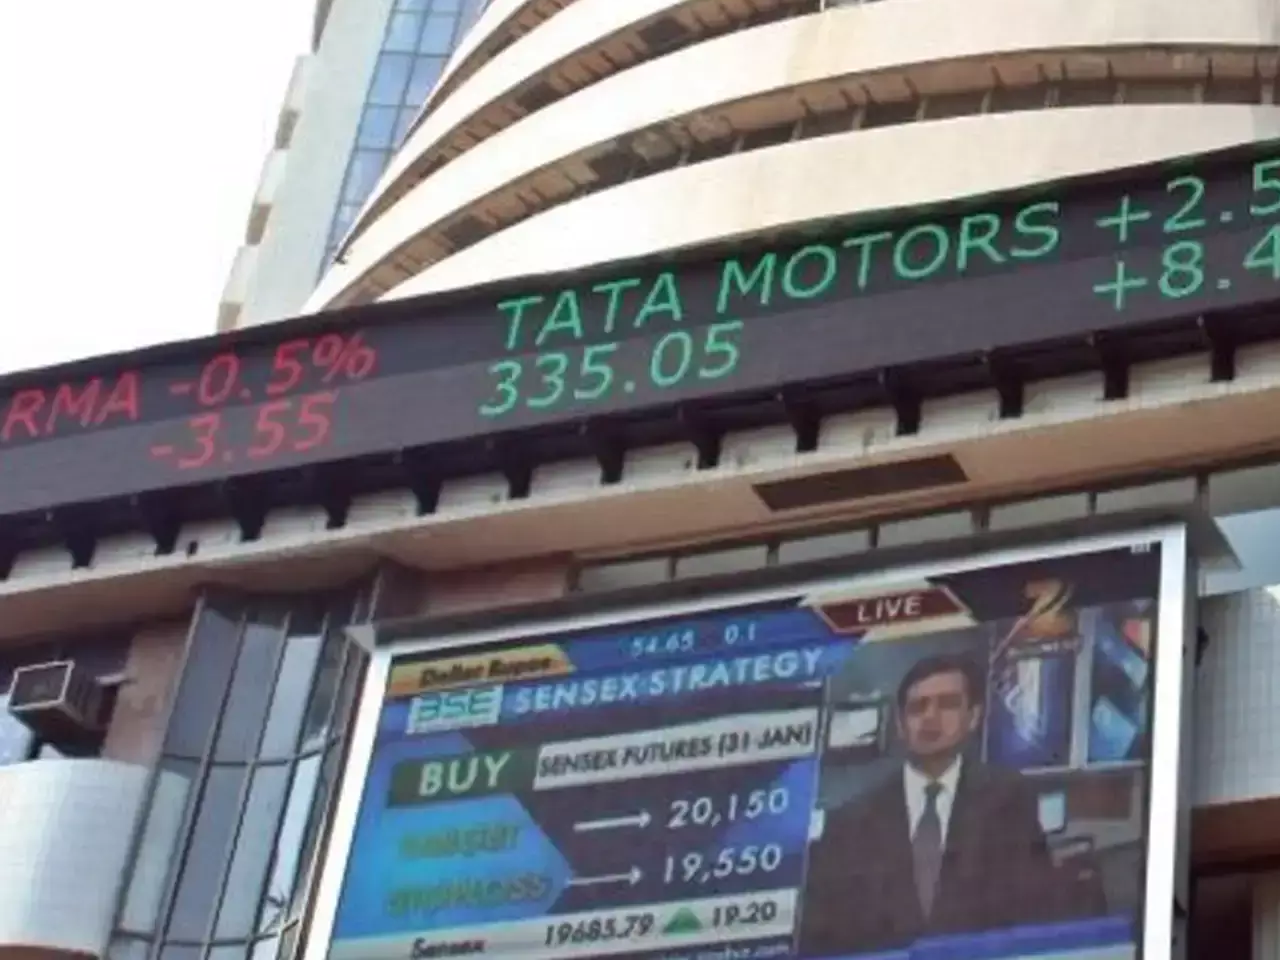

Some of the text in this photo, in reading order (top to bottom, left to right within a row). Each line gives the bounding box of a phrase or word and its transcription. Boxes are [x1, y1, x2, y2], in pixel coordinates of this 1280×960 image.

[497, 272, 683, 350] TATA
[716, 201, 1062, 314] MOTORS
[1, 332, 377, 440] RMA -0.5%
[479, 321, 744, 417] 335.05
[150, 388, 340, 469] -3.55
[857, 596, 923, 623] LIVE
[513, 646, 823, 715] SENSEX STRATEGY
[418, 752, 511, 797] BUY
[537, 748, 618, 779] SENSEX
[621, 735, 715, 769] FUTURES
[665, 787, 789, 829] 20,150
[663, 842, 783, 885] 19,550
